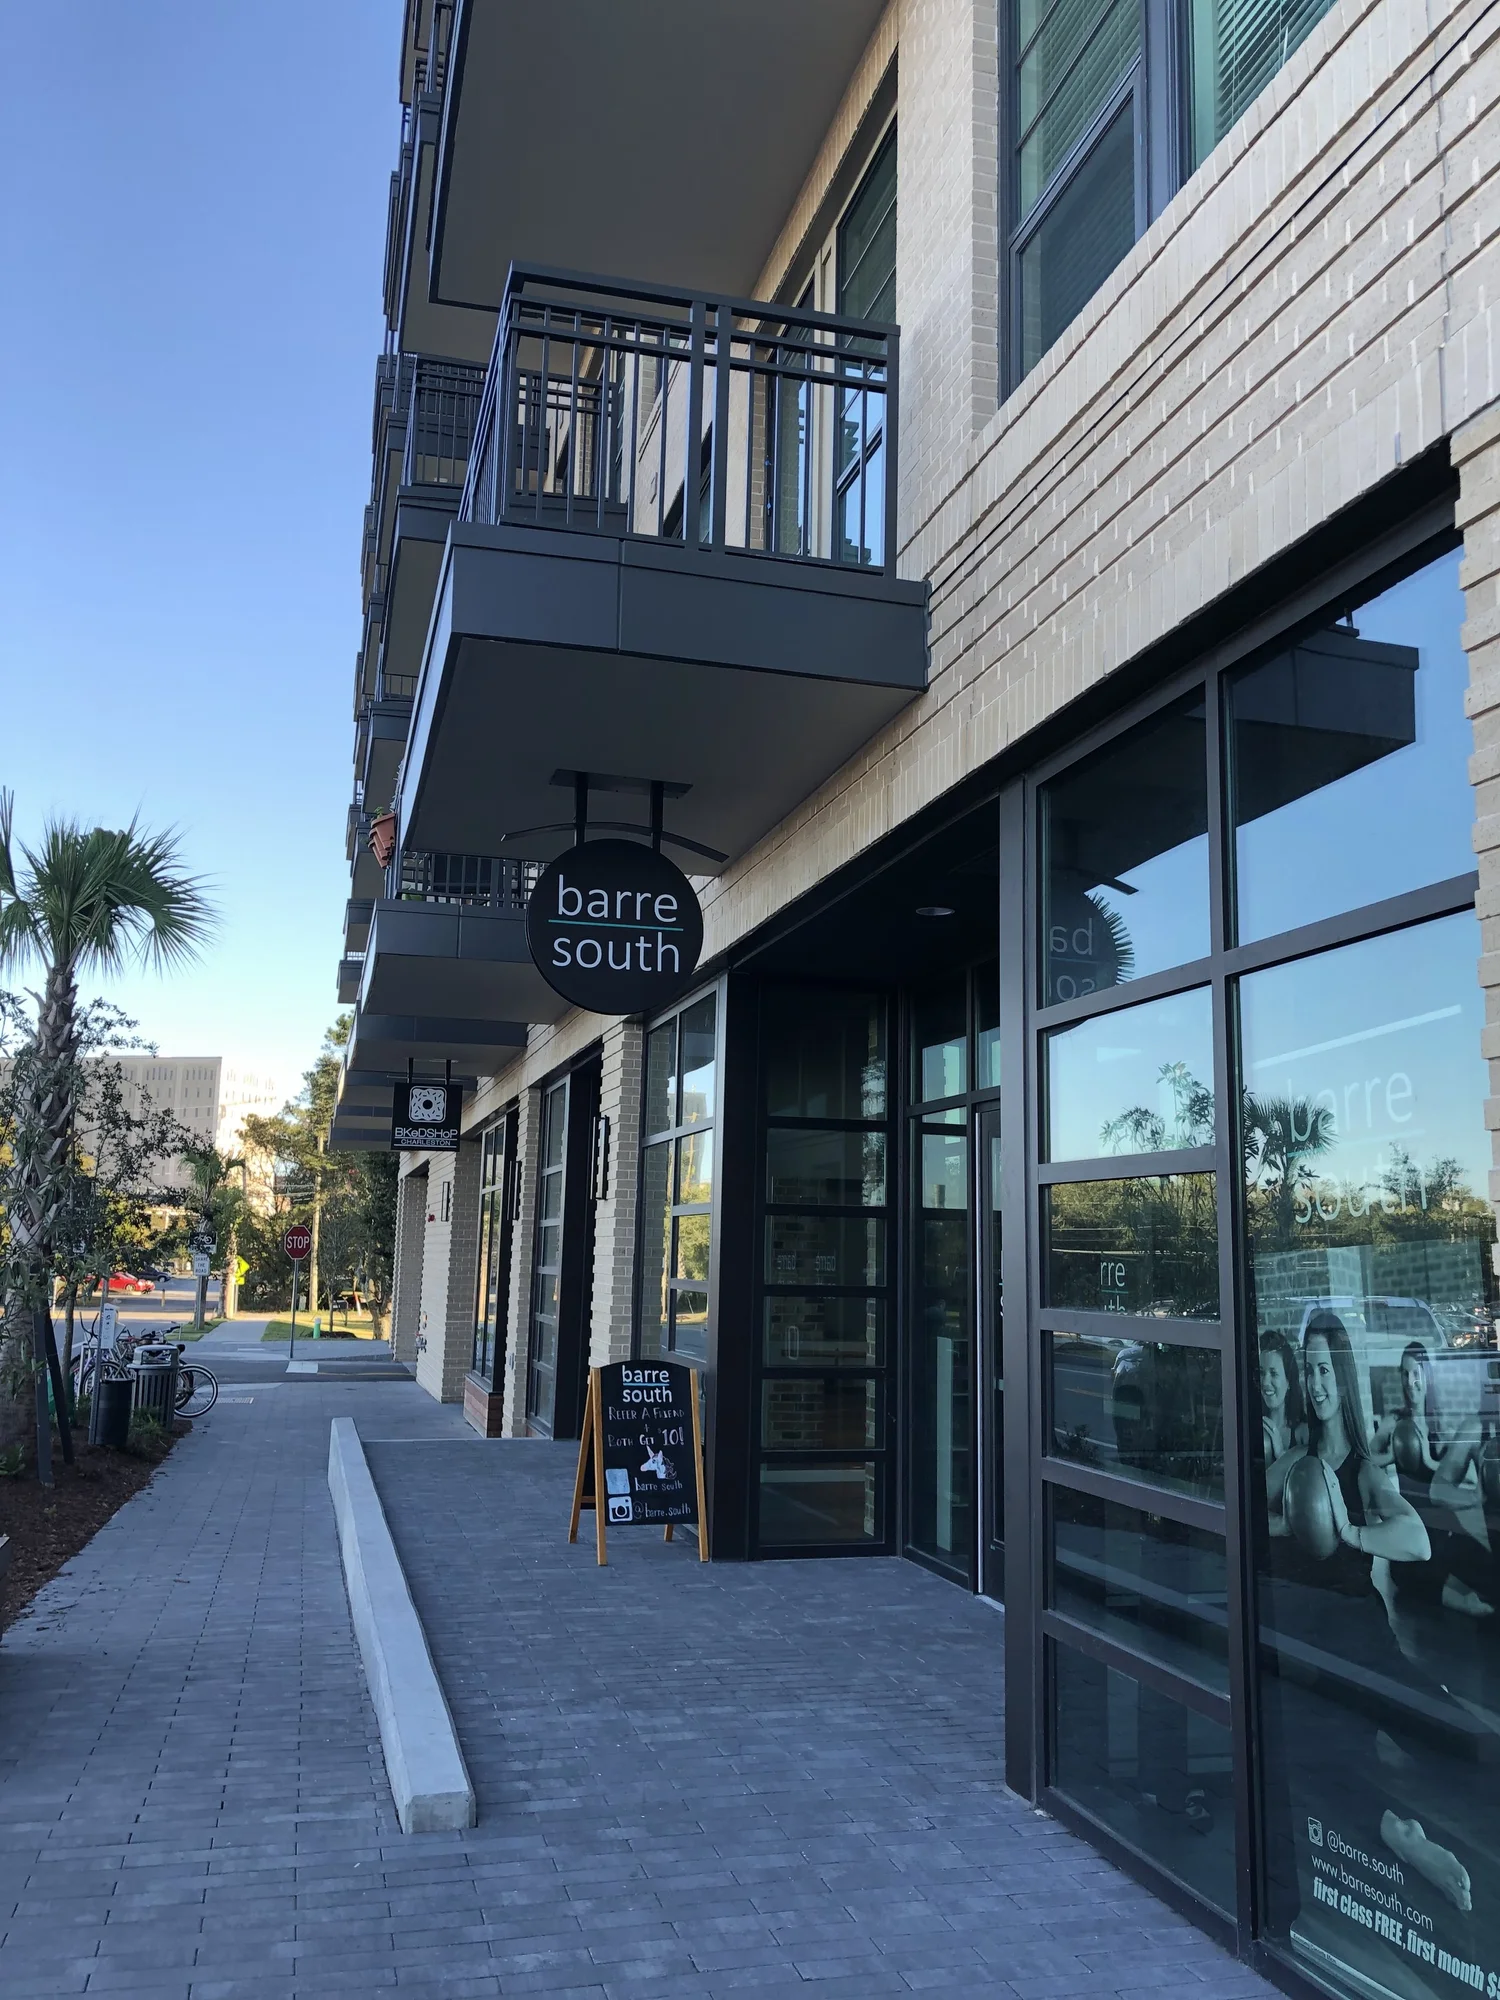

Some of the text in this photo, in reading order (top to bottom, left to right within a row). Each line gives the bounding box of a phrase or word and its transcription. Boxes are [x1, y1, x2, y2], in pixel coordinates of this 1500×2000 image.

[558, 874, 678, 923] barre
[552, 931, 680, 973] south
[1287, 1072, 1413, 1142] barre
[1288, 1153, 1427, 1224] south
[287, 1236, 310, 1249] STOP
[621, 1364, 670, 1383] barre
[622, 1386, 672, 1403] south
[608, 1406, 637, 1420] REFER
[641, 1407, 650, 1419] A
[639, 1434, 655, 1446] GET
[634, 1477, 683, 1491] barre south
[1327, 1830, 1405, 1885] @barre.south
[1311, 1854, 1434, 1932] www.barresouth.com
[1313, 1877, 1339, 1910] first
[1340, 1894, 1373, 1930] class
[1374, 1909, 1407, 1951] FREE,
[1407, 1928, 1436, 1965] first
[1437, 1948, 1485, 1992] month
